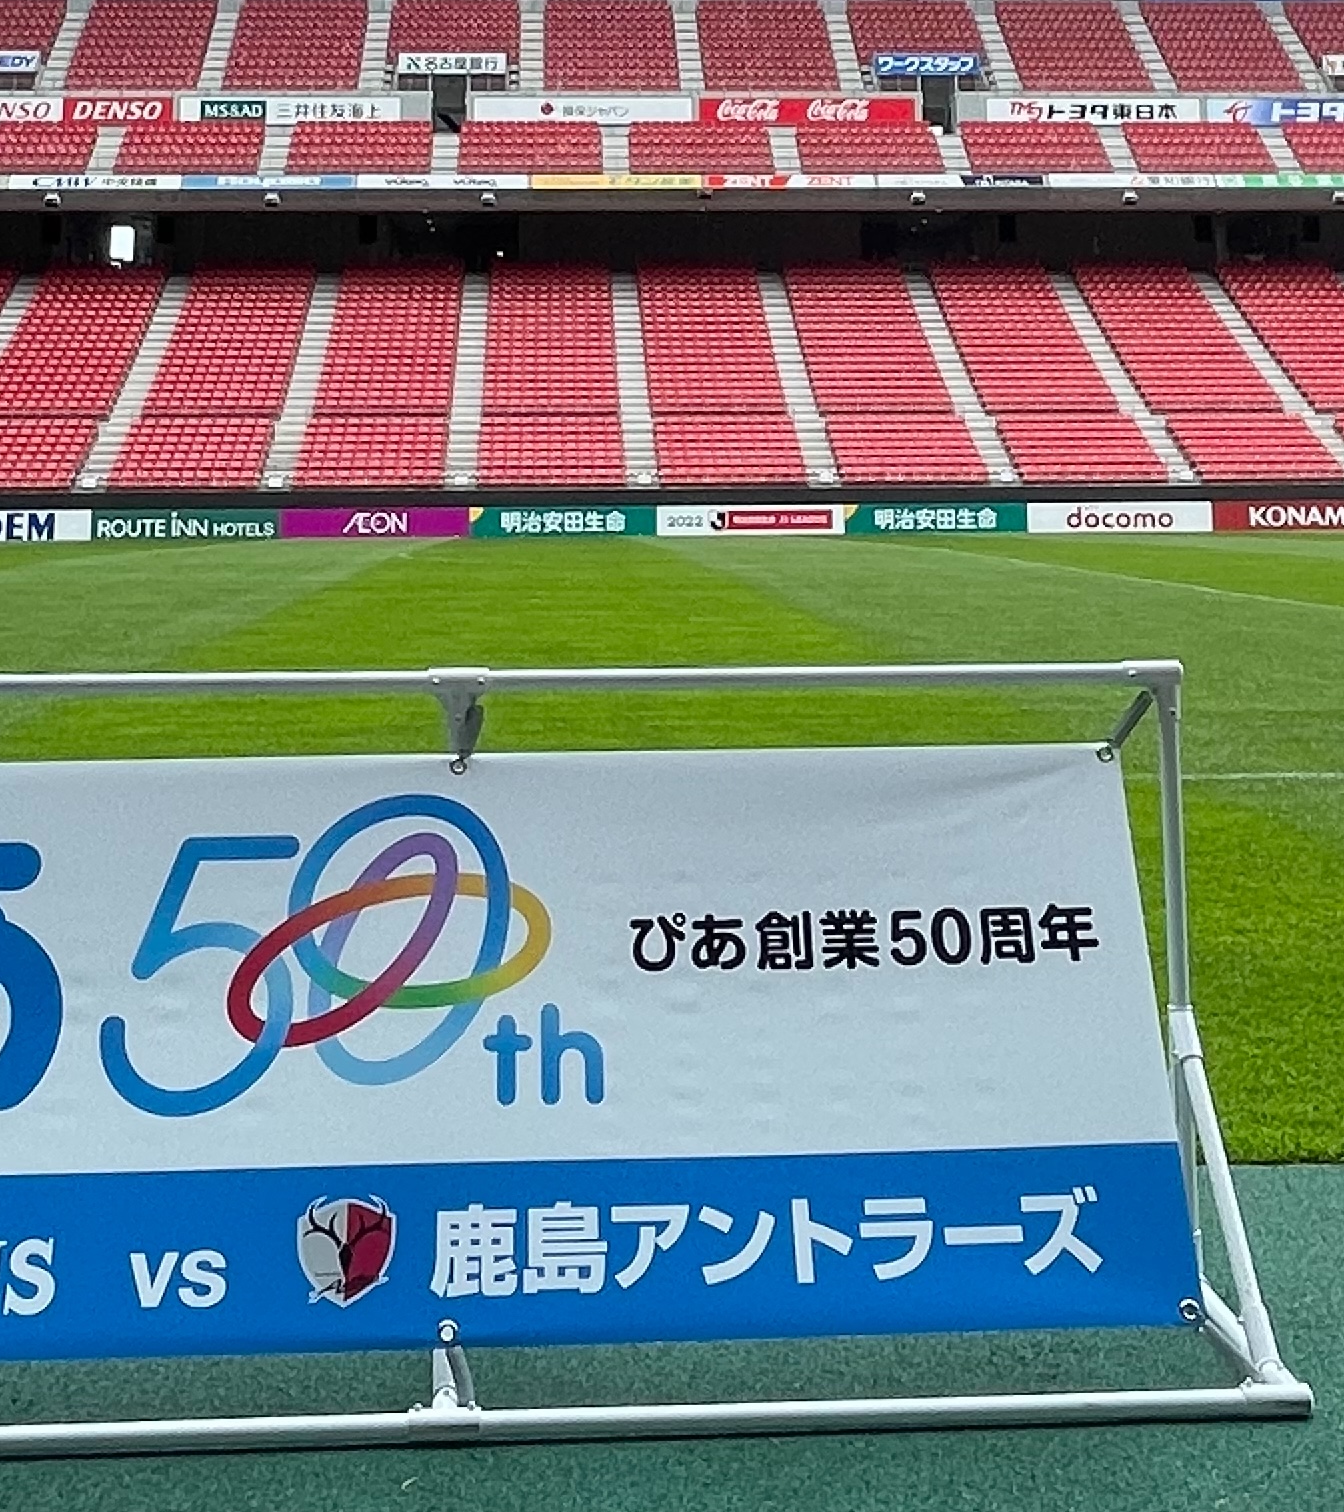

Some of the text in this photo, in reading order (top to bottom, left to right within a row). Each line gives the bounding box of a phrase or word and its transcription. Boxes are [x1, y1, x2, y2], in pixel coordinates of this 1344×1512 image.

[72, 101, 162, 120] DENSO
[1047, 102, 1177, 118] トヨタ東日本
[96, 519, 166, 537] ROUTE
[212, 523, 275, 537] HOTELS
[499, 510, 626, 533] 明治安田生命
[874, 509, 998, 530] 明治安田生命
[1066, 507, 1174, 529] docomo
[628, 903, 1100, 972] ぴあ創業50周年
[430, 1185, 1104, 1299] 鹿島アントラーズ
